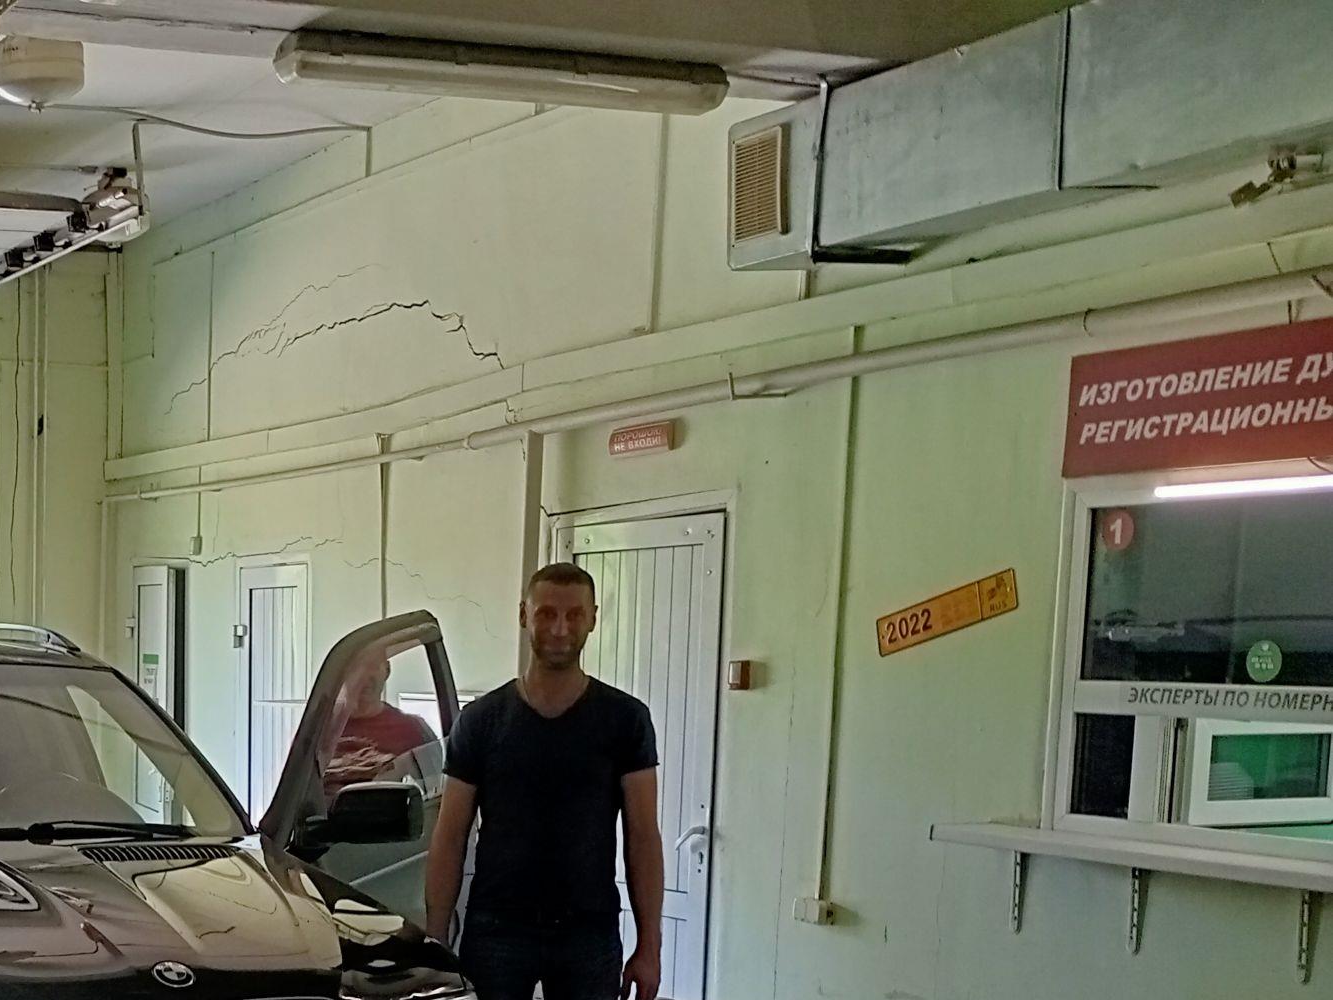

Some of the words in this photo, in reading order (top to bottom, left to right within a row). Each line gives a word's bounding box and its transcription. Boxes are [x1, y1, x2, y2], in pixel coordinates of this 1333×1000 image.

[1078, 357, 1293, 407] ИЗГОТОВЛЕНИЕ
[614, 443, 626, 453] НЕ
[628, 436, 661, 450] ВХОДИ!
[1110, 518, 1123, 545] 1
[885, 608, 933, 644] 2022
[1128, 687, 1219, 706] ЭКСПЕРТЫ
[1223, 690, 1249, 708] ПО
